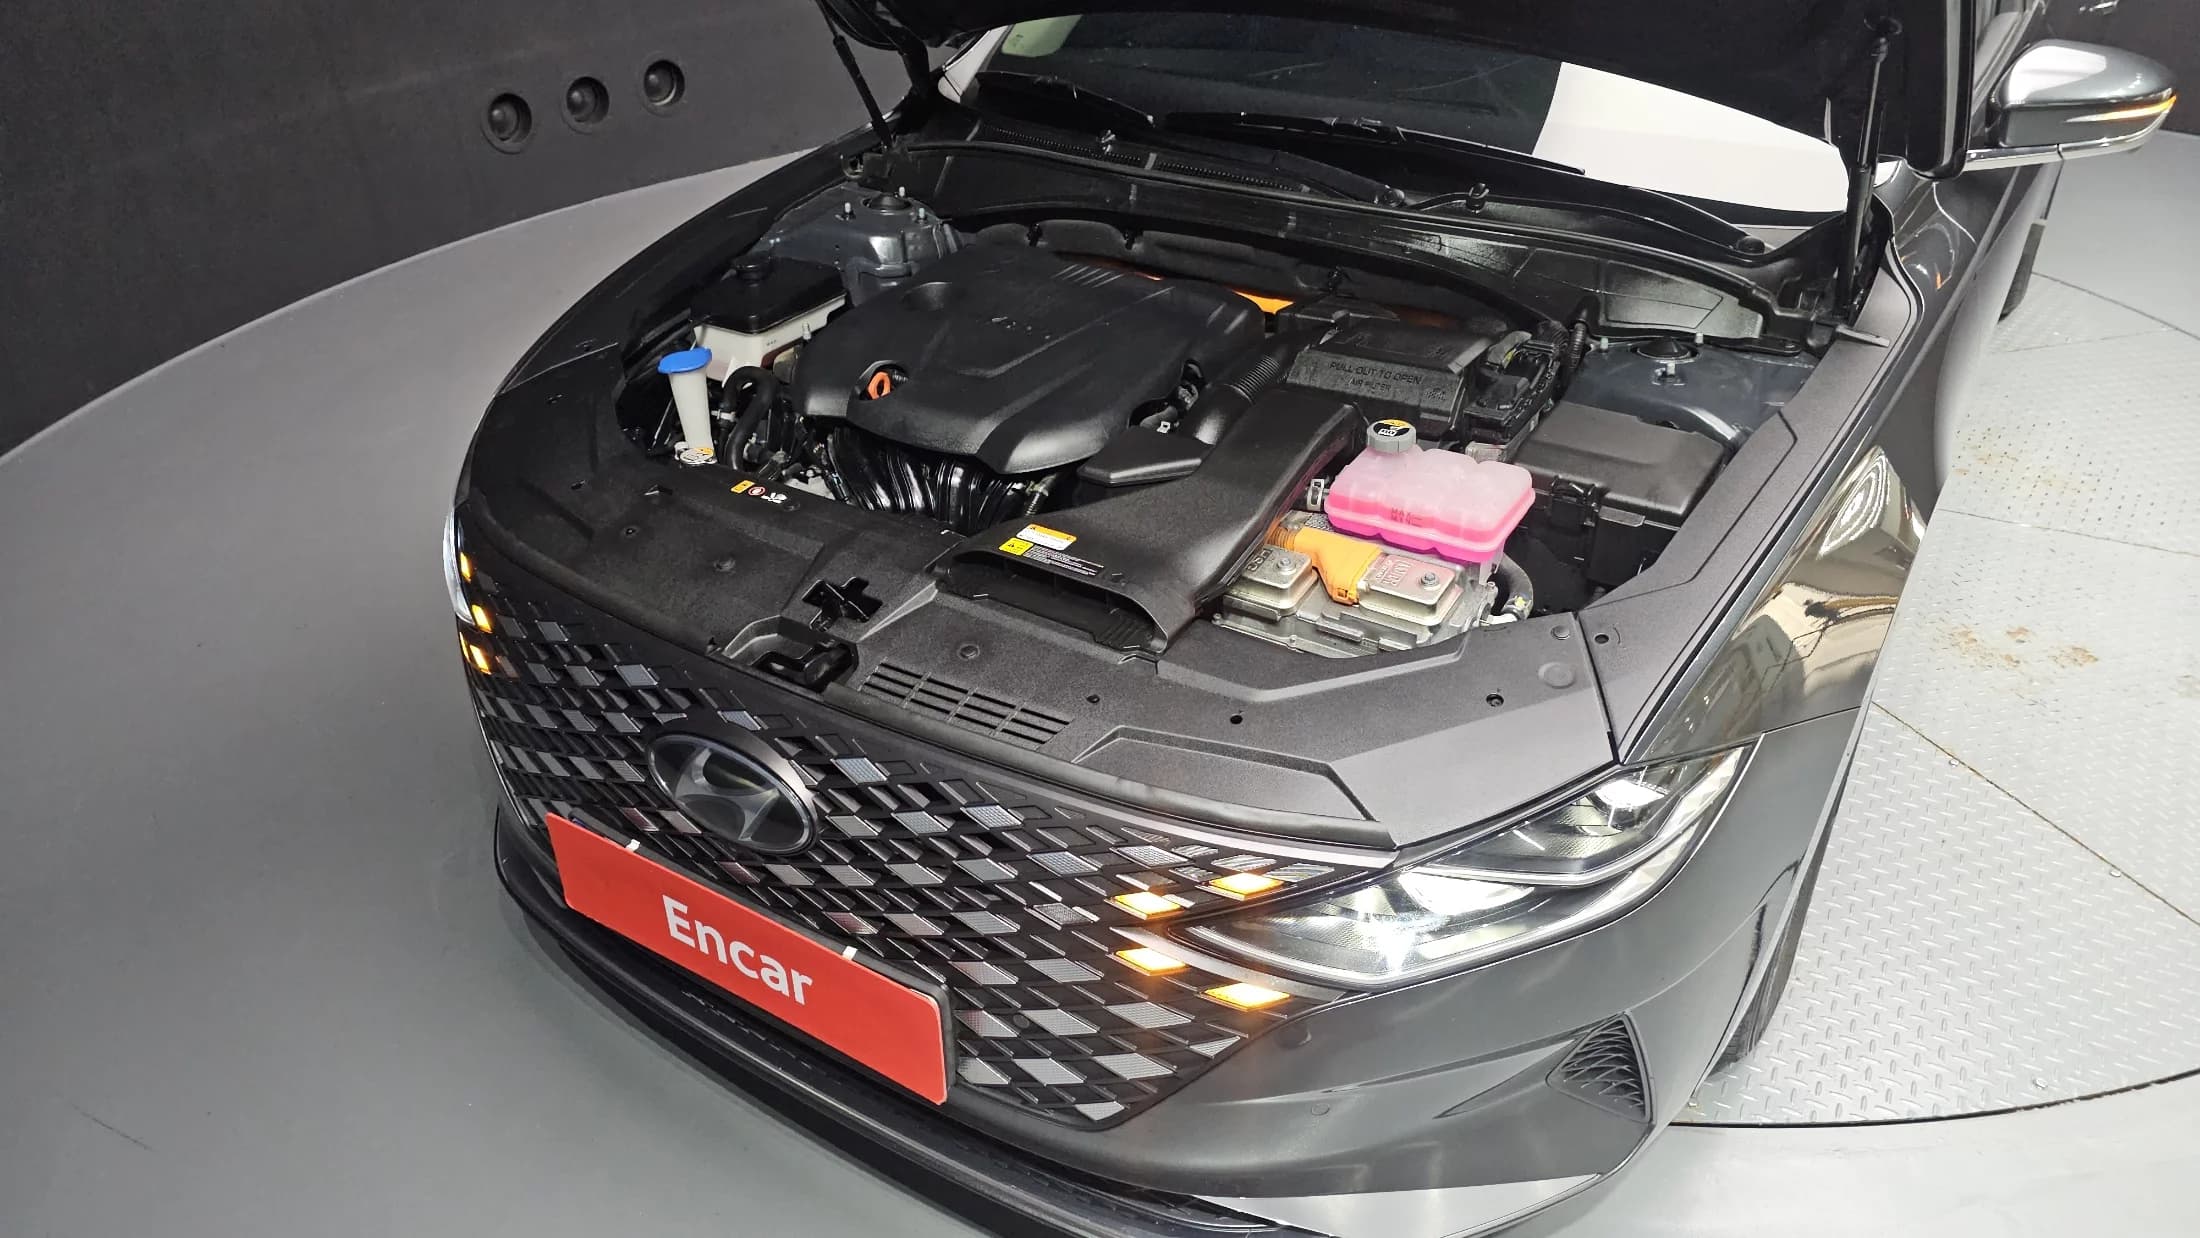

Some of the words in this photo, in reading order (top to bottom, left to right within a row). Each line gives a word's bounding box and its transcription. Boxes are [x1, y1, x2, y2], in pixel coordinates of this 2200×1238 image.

[1330, 361, 1353, 374] PULL
[1355, 366, 1377, 377] OUT
[1379, 369, 1392, 380] TO
[1393, 372, 1422, 386] OPEN
[662, 894, 813, 1006] Encar
